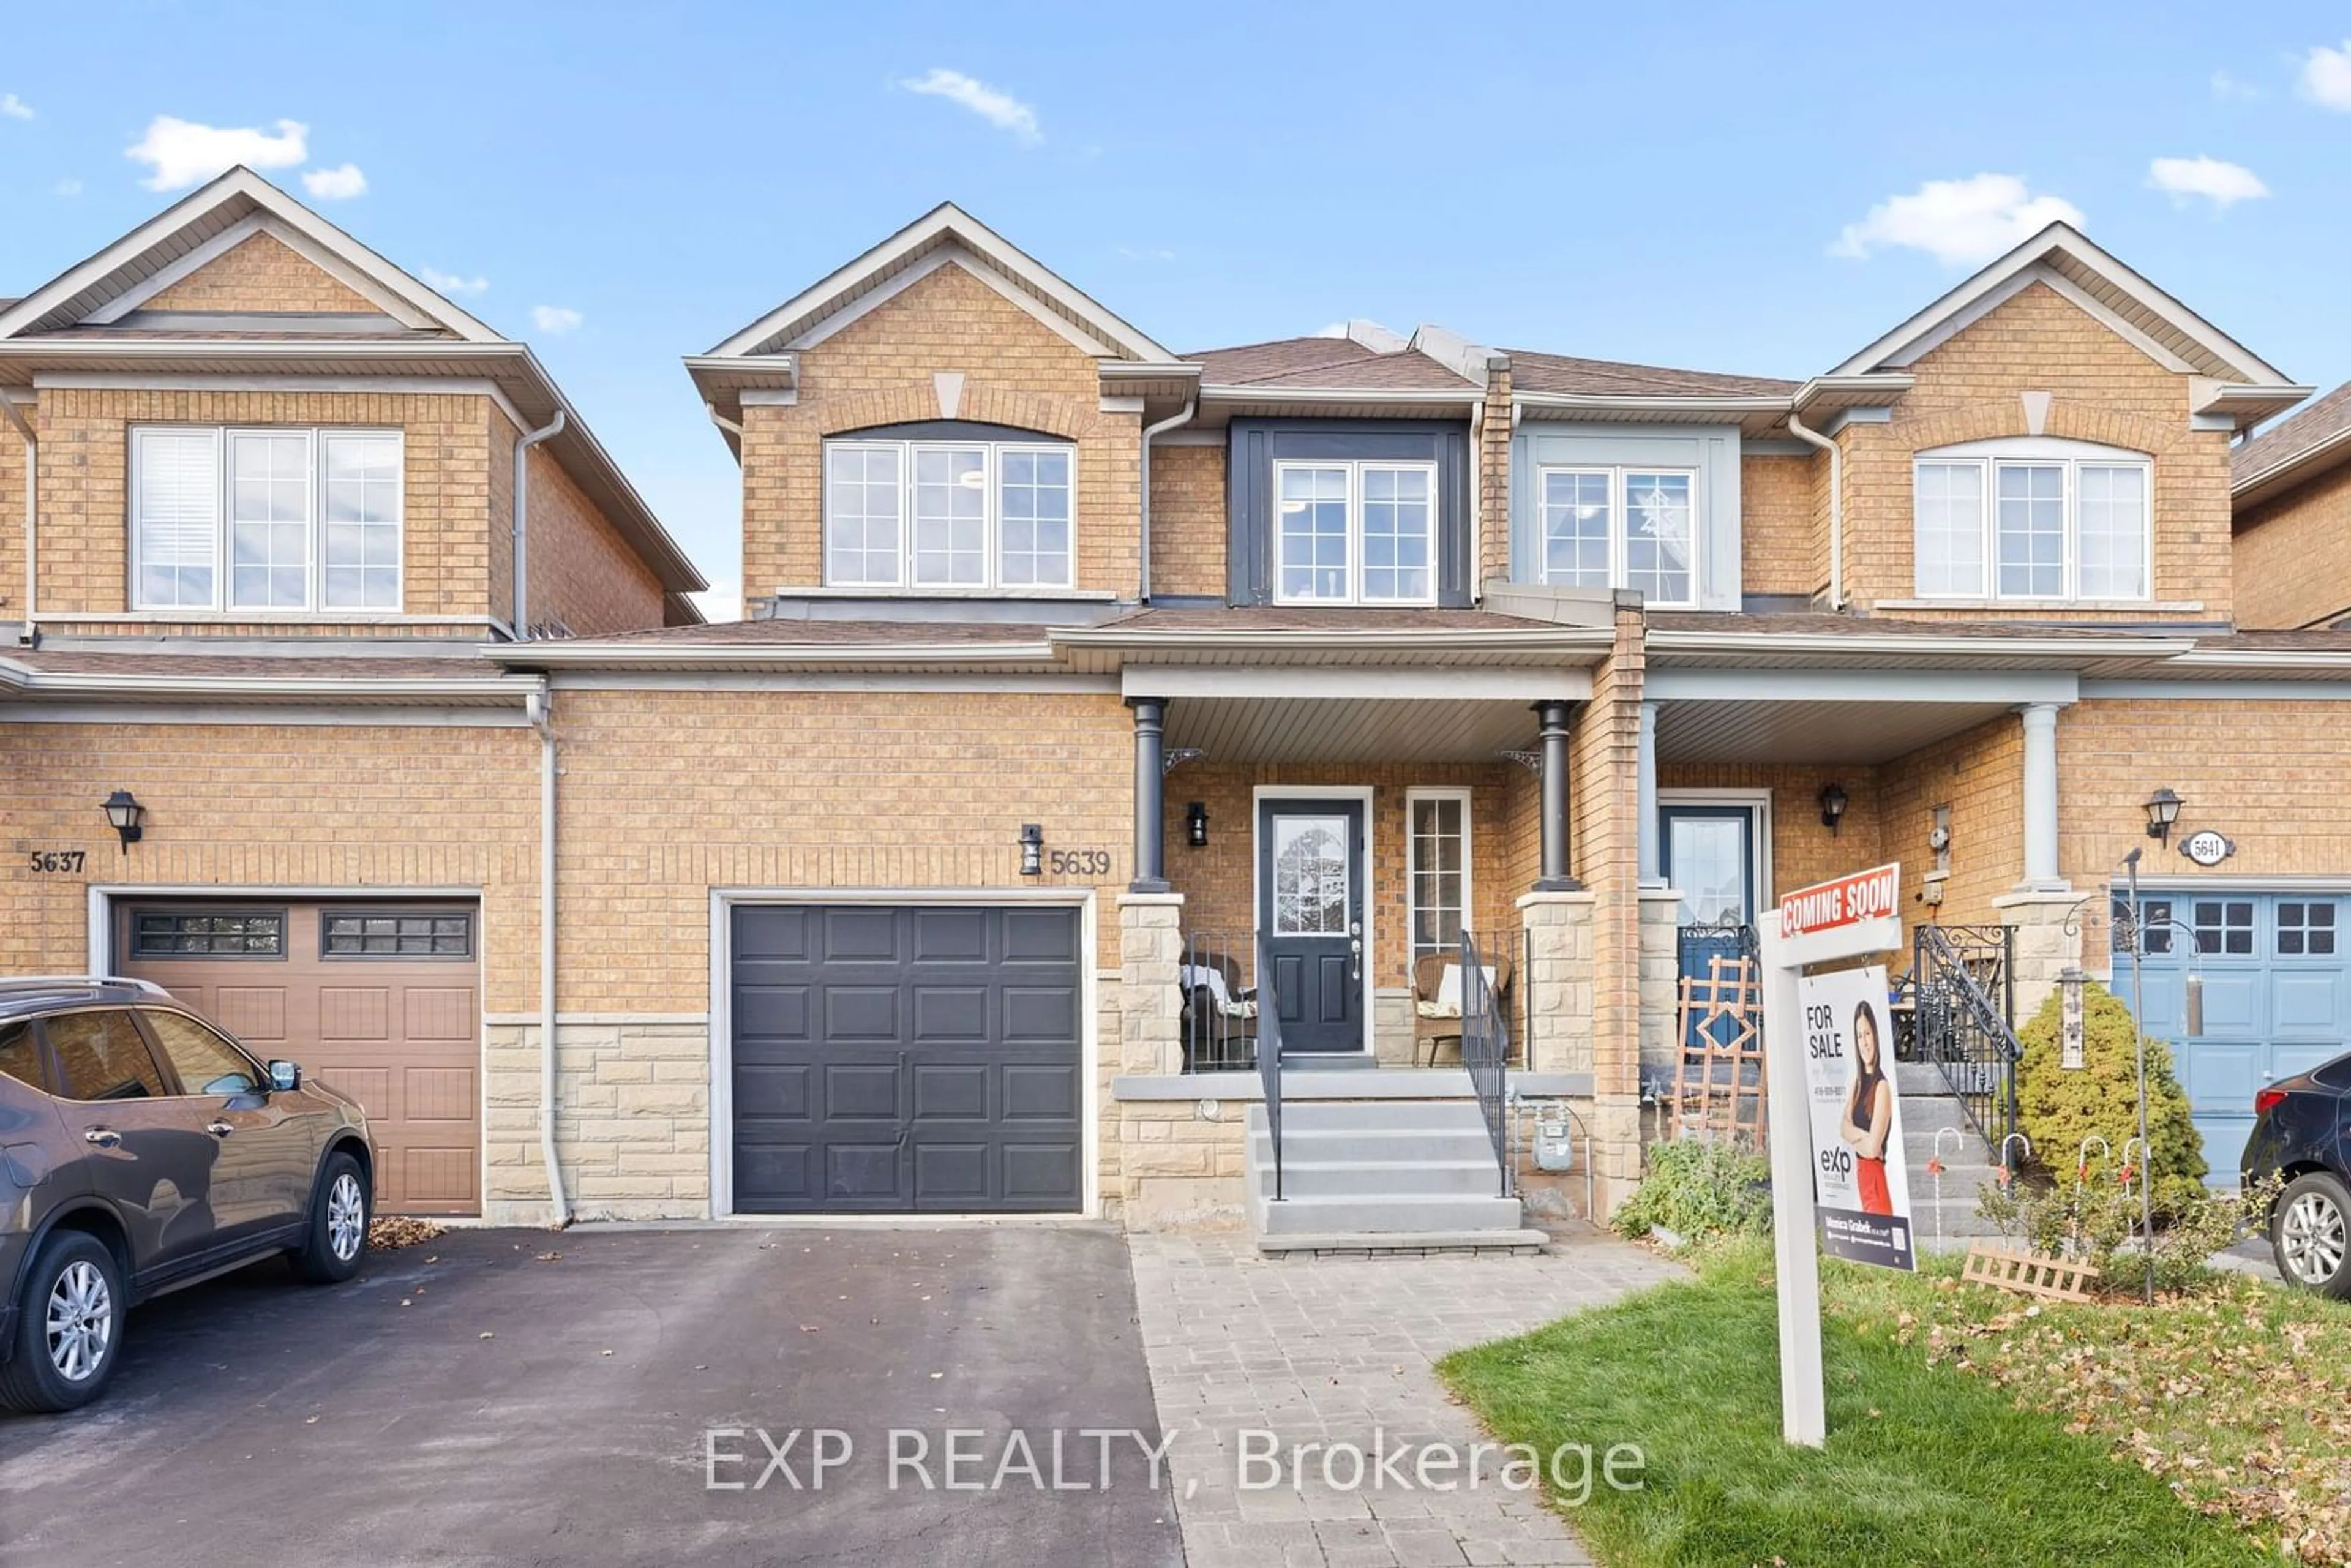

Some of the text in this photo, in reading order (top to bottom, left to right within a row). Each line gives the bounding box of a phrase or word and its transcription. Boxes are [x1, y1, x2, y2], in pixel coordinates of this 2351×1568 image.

[2195, 840, 2219, 856] 5641
[31, 851, 85, 873] 5637
[1051, 850, 1111, 875] 5639
[1783, 875, 1892, 934] COMING SOON
[1807, 1005, 1834, 1030] FOR
[1809, 1033, 1843, 1059] SALE
